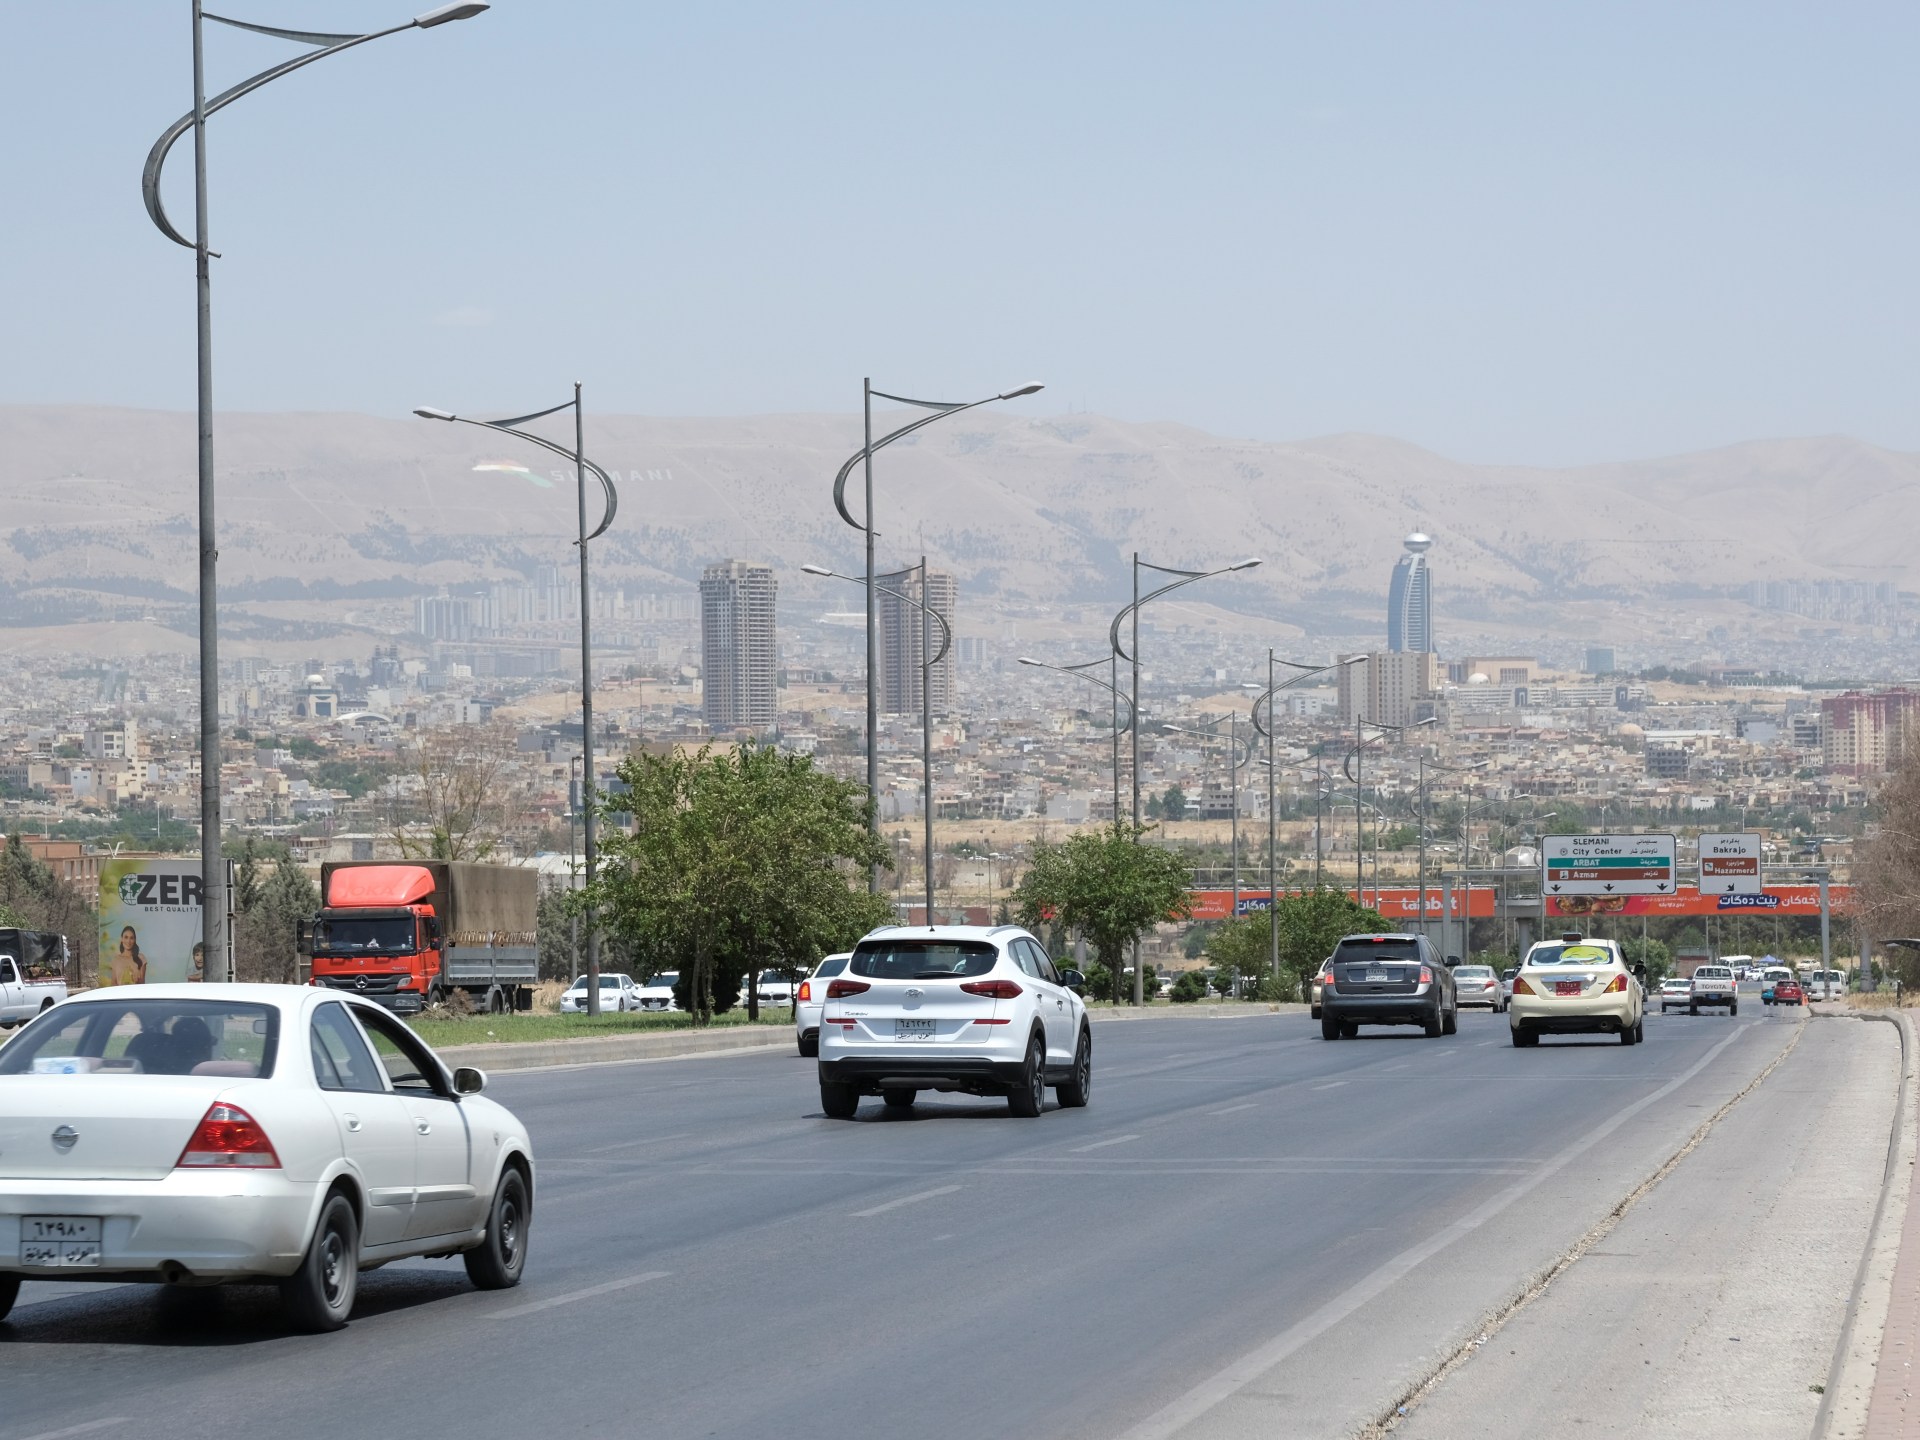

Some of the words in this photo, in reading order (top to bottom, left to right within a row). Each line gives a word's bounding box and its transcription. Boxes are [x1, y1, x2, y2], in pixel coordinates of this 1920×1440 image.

[1572, 848, 1590, 856] City
[1713, 846, 1746, 854] Bakrajo
[1573, 858, 1600, 867] ARBAT
[137, 875, 203, 905] ZER
